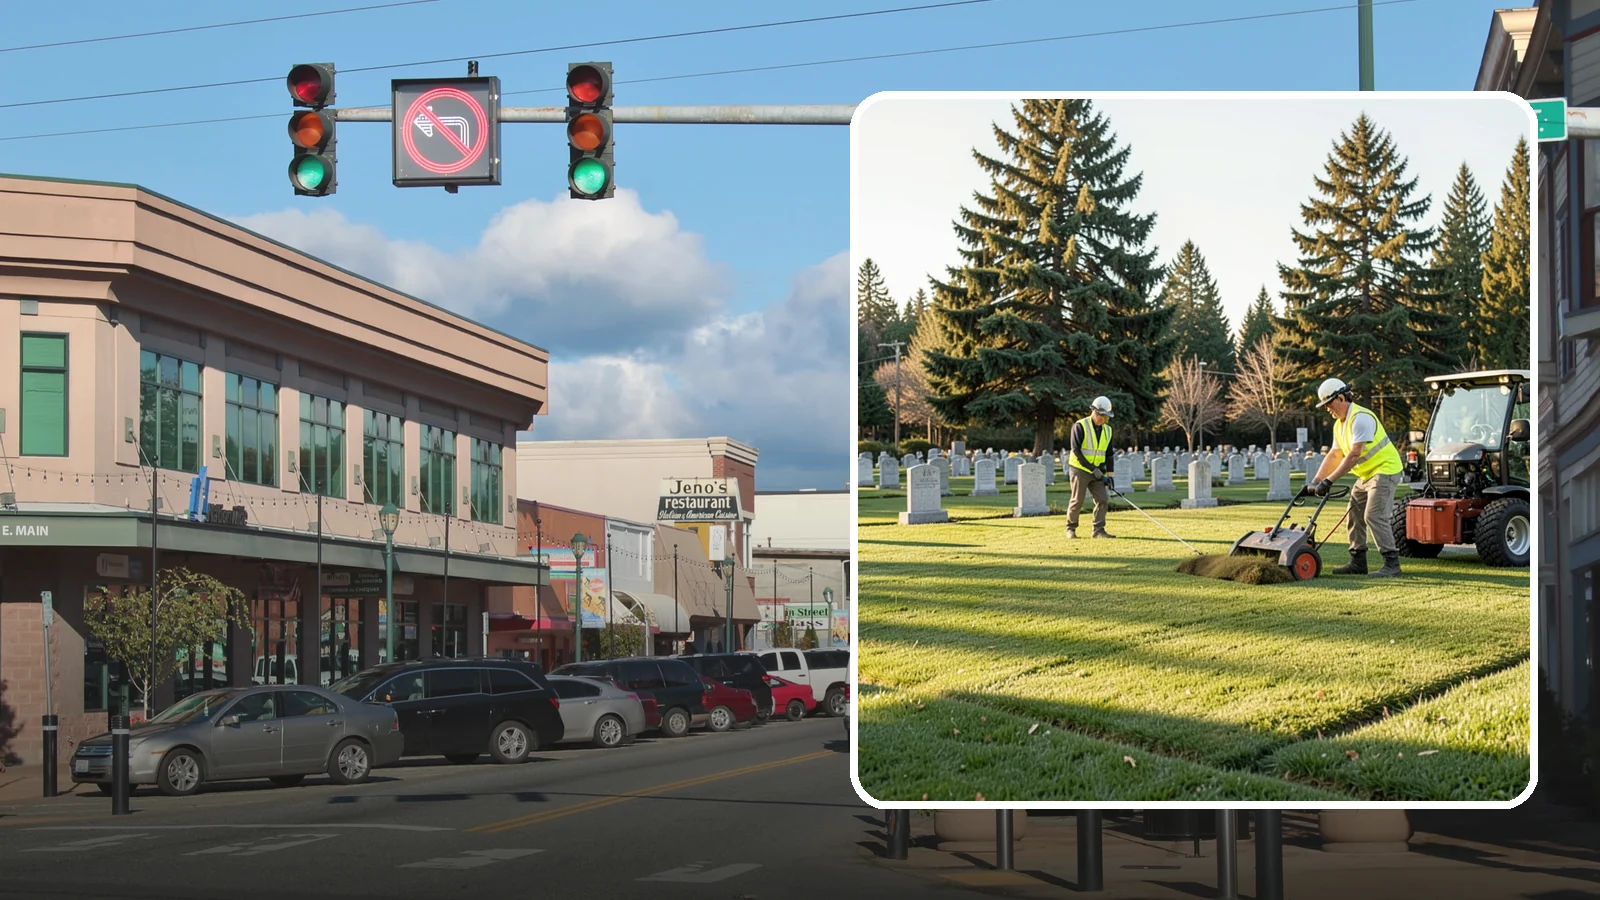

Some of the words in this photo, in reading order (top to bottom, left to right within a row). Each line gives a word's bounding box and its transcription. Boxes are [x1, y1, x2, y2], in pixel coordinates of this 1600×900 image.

[670, 480, 727, 494] Jeno's
[665, 496, 731, 509] restaurant
[685, 509, 715, 520] American
[714, 509, 738, 520] Cuisine
[2, 525, 13, 536] E.
[16, 525, 49, 536] MAIN
[797, 607, 828, 617] Street
